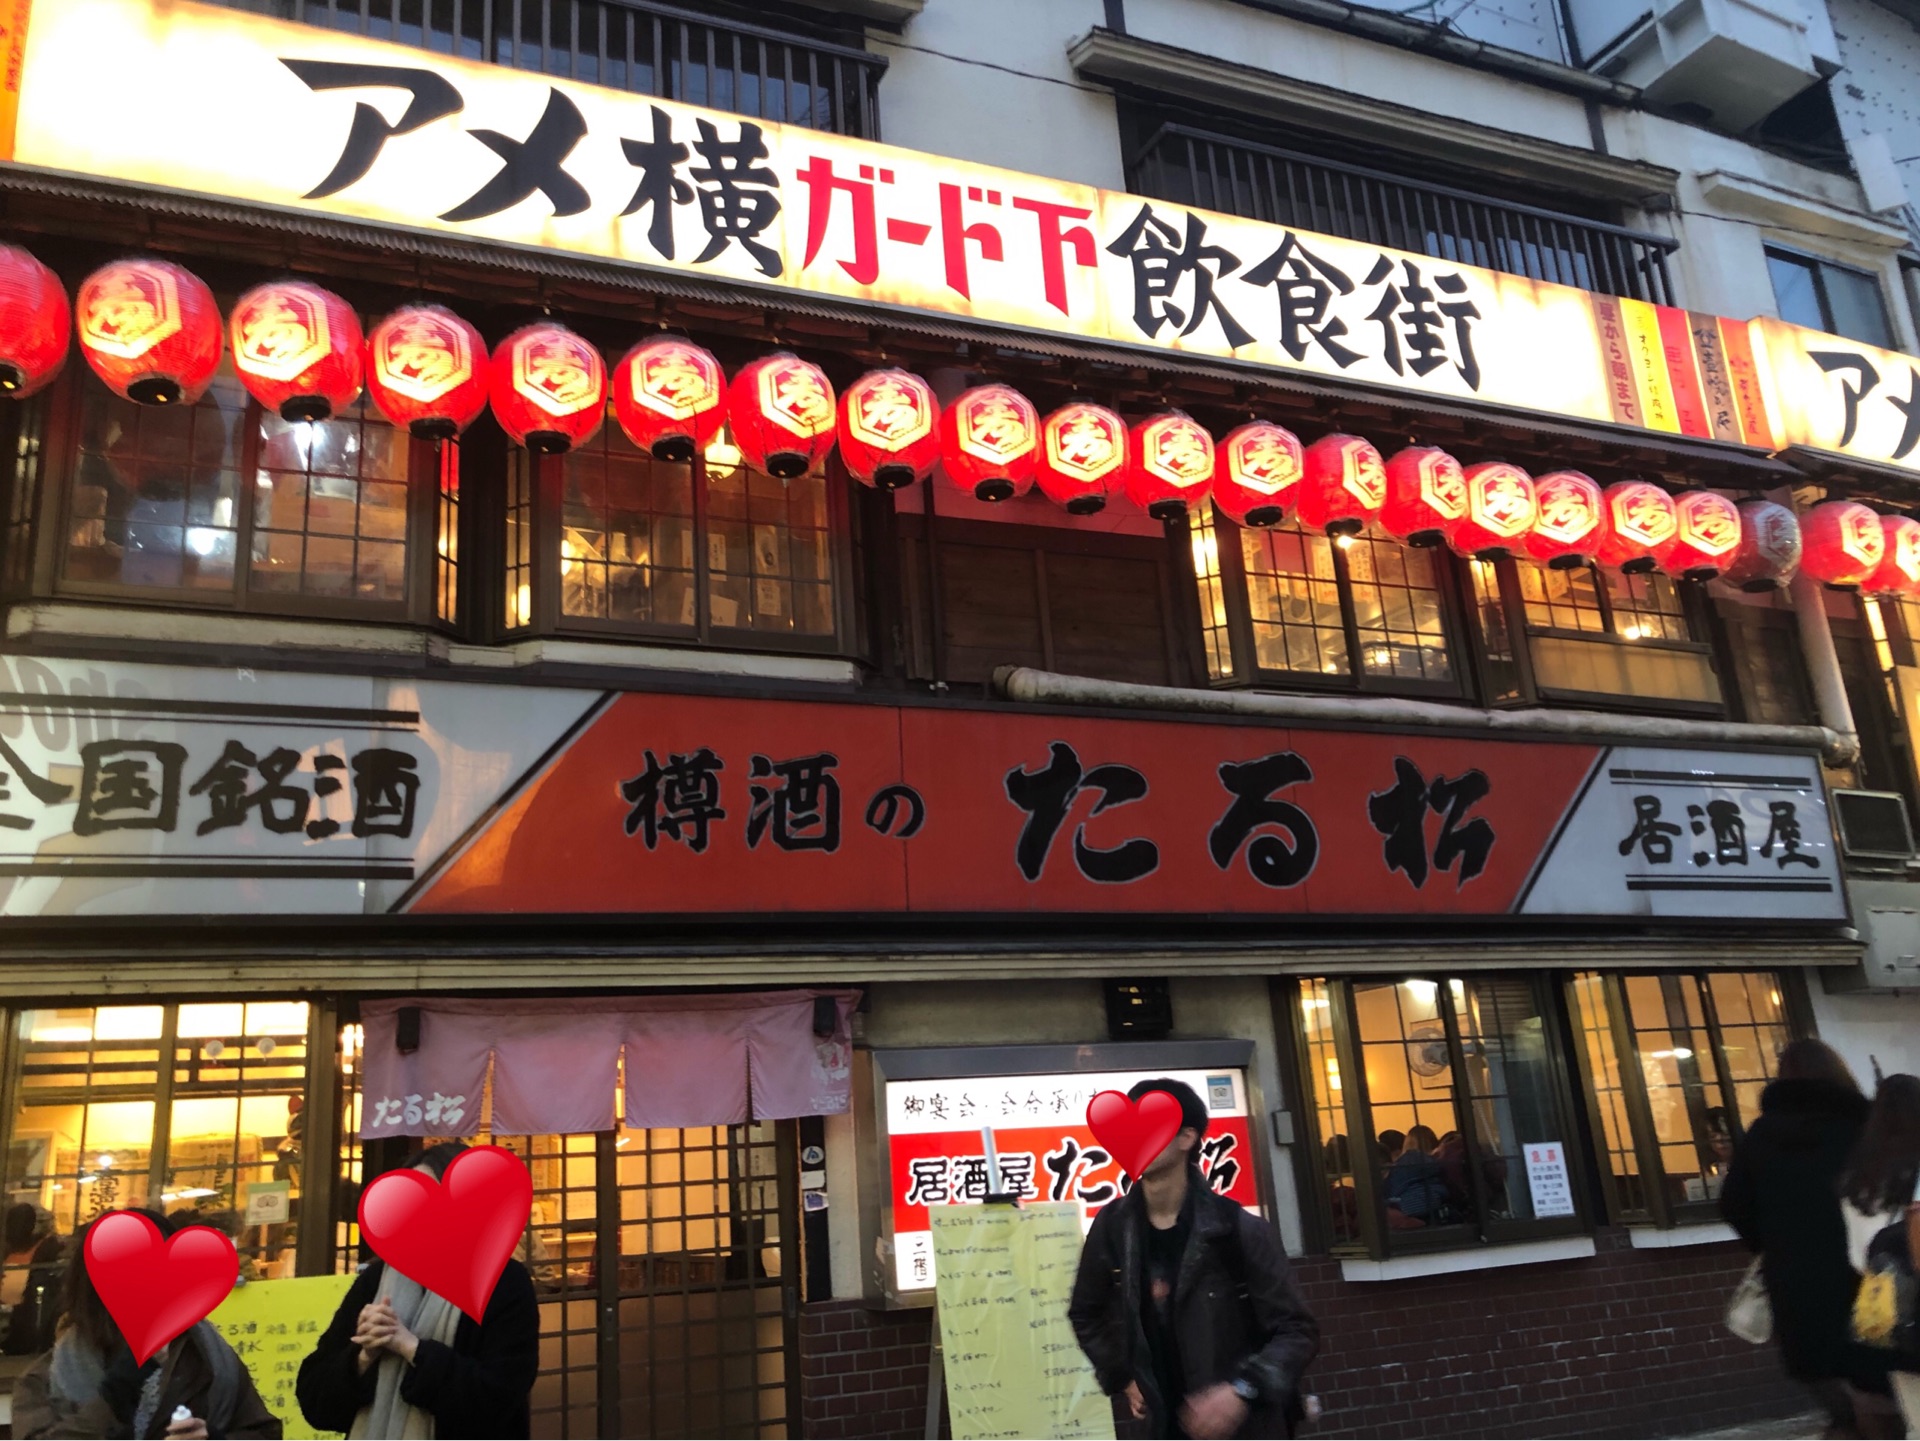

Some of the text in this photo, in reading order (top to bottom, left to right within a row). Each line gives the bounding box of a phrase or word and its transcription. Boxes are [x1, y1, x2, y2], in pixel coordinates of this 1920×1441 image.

[618, 739, 1497, 890] 樽酒の たる松
[1618, 795, 1820, 869] 居酒屋
[372, 1091, 467, 1128] たる松
[905, 1153, 1036, 1206] 居酒屋
